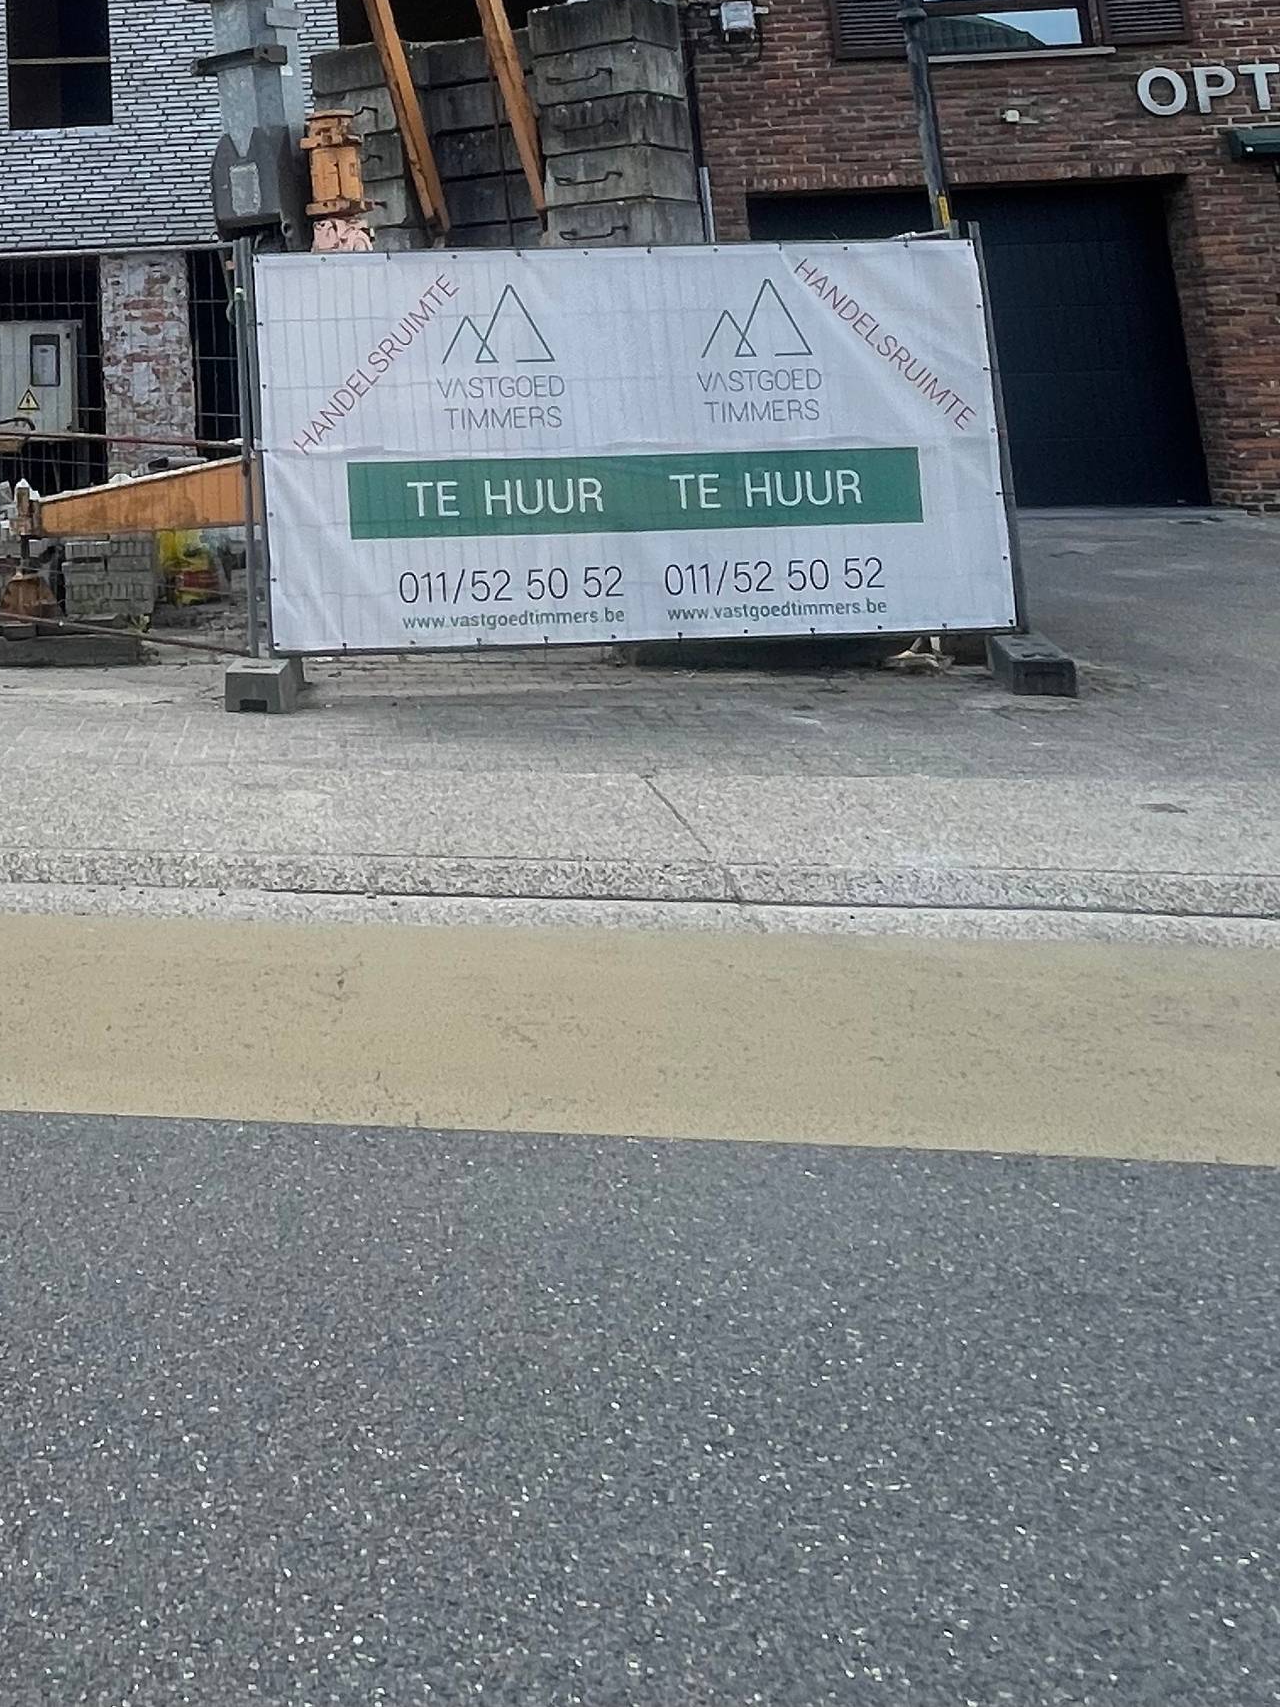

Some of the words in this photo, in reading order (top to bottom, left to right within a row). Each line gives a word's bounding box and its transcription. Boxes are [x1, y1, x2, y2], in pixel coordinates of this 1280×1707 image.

[1137, 63, 1280, 116] OPT
[793, 258, 977, 431] HANDELSRUIMTE
[293, 274, 460, 455] HANDELSRUIMTE
[696, 368, 821, 392] VASTGOED
[436, 375, 565, 398] VASTGOED
[444, 405, 563, 430] TIMMERS
[704, 398, 820, 423] TIMMERS
[406, 481, 460, 517] TE
[484, 477, 604, 515] HUUR
[669, 473, 721, 509] TE
[744, 469, 863, 507] HUUR
[399, 568, 513, 605] 011/52
[527, 567, 569, 600] 50
[583, 565, 625, 598] 52
[664, 560, 775, 595] 011/52
[787, 559, 830, 591] 50
[844, 557, 885, 589] 52
[402, 607, 625, 630] www.vastgoedtimmers.be
[667, 598, 888, 622] www.vastgoedtimmers.be
